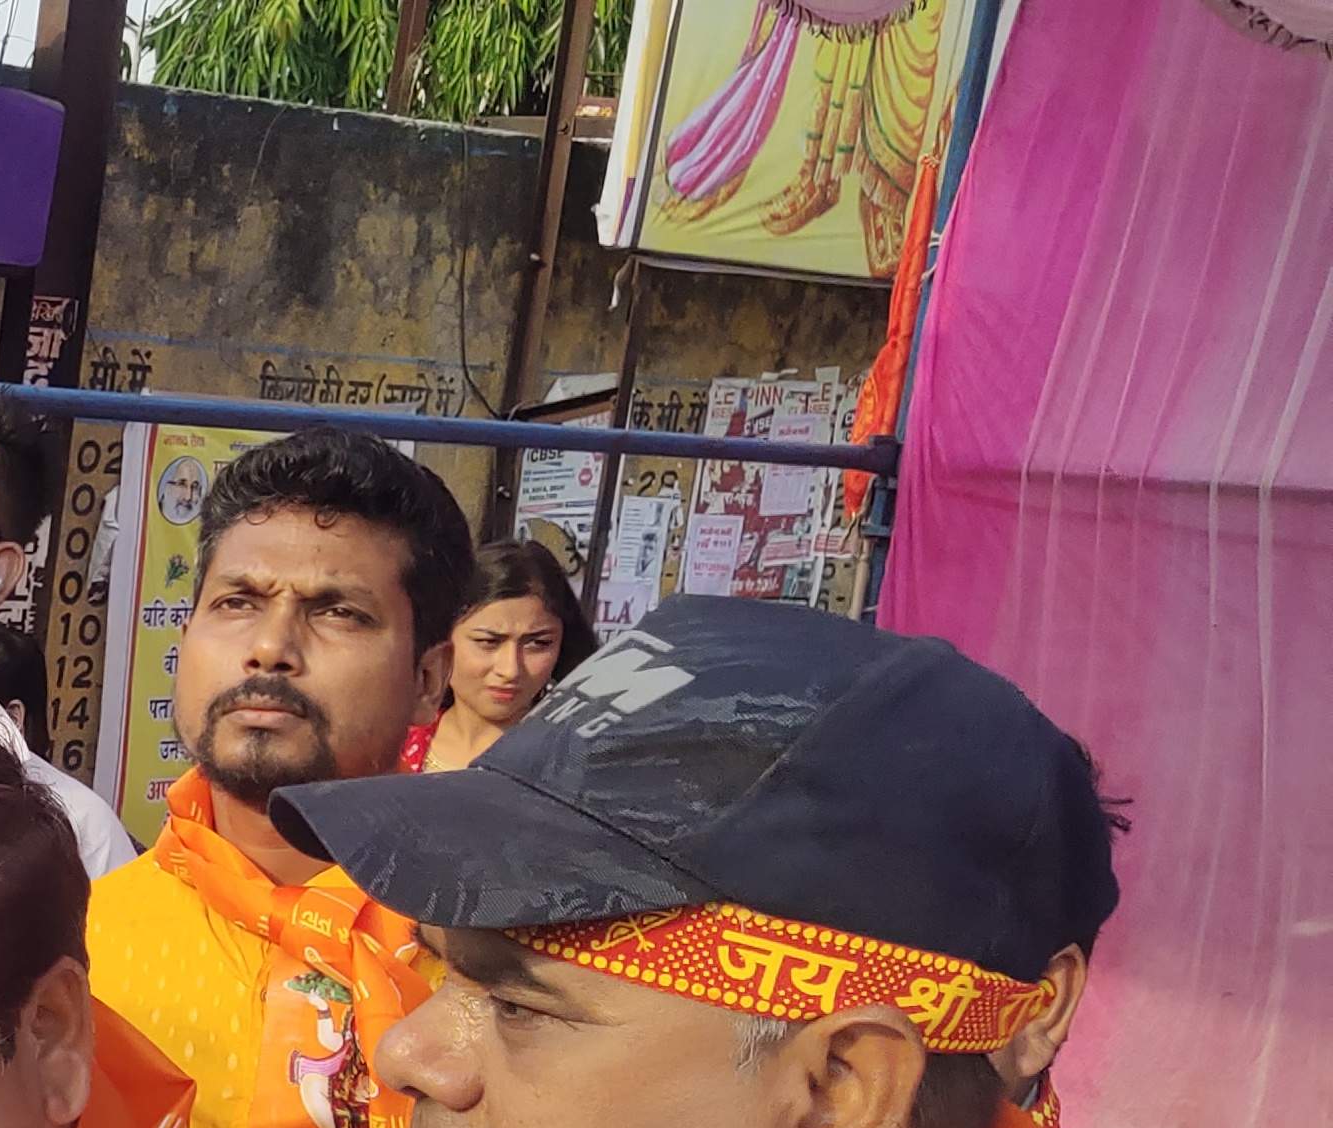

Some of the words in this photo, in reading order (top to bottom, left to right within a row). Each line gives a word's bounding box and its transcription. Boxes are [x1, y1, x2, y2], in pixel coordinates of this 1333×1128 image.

[60, 612, 101, 646] 10
[143, 599, 169, 628] यदि
[56, 655, 95, 689] 12
[50, 696, 90, 730] 14
[717, 928, 859, 1015] जय
[894, 974, 982, 1039] श्री
